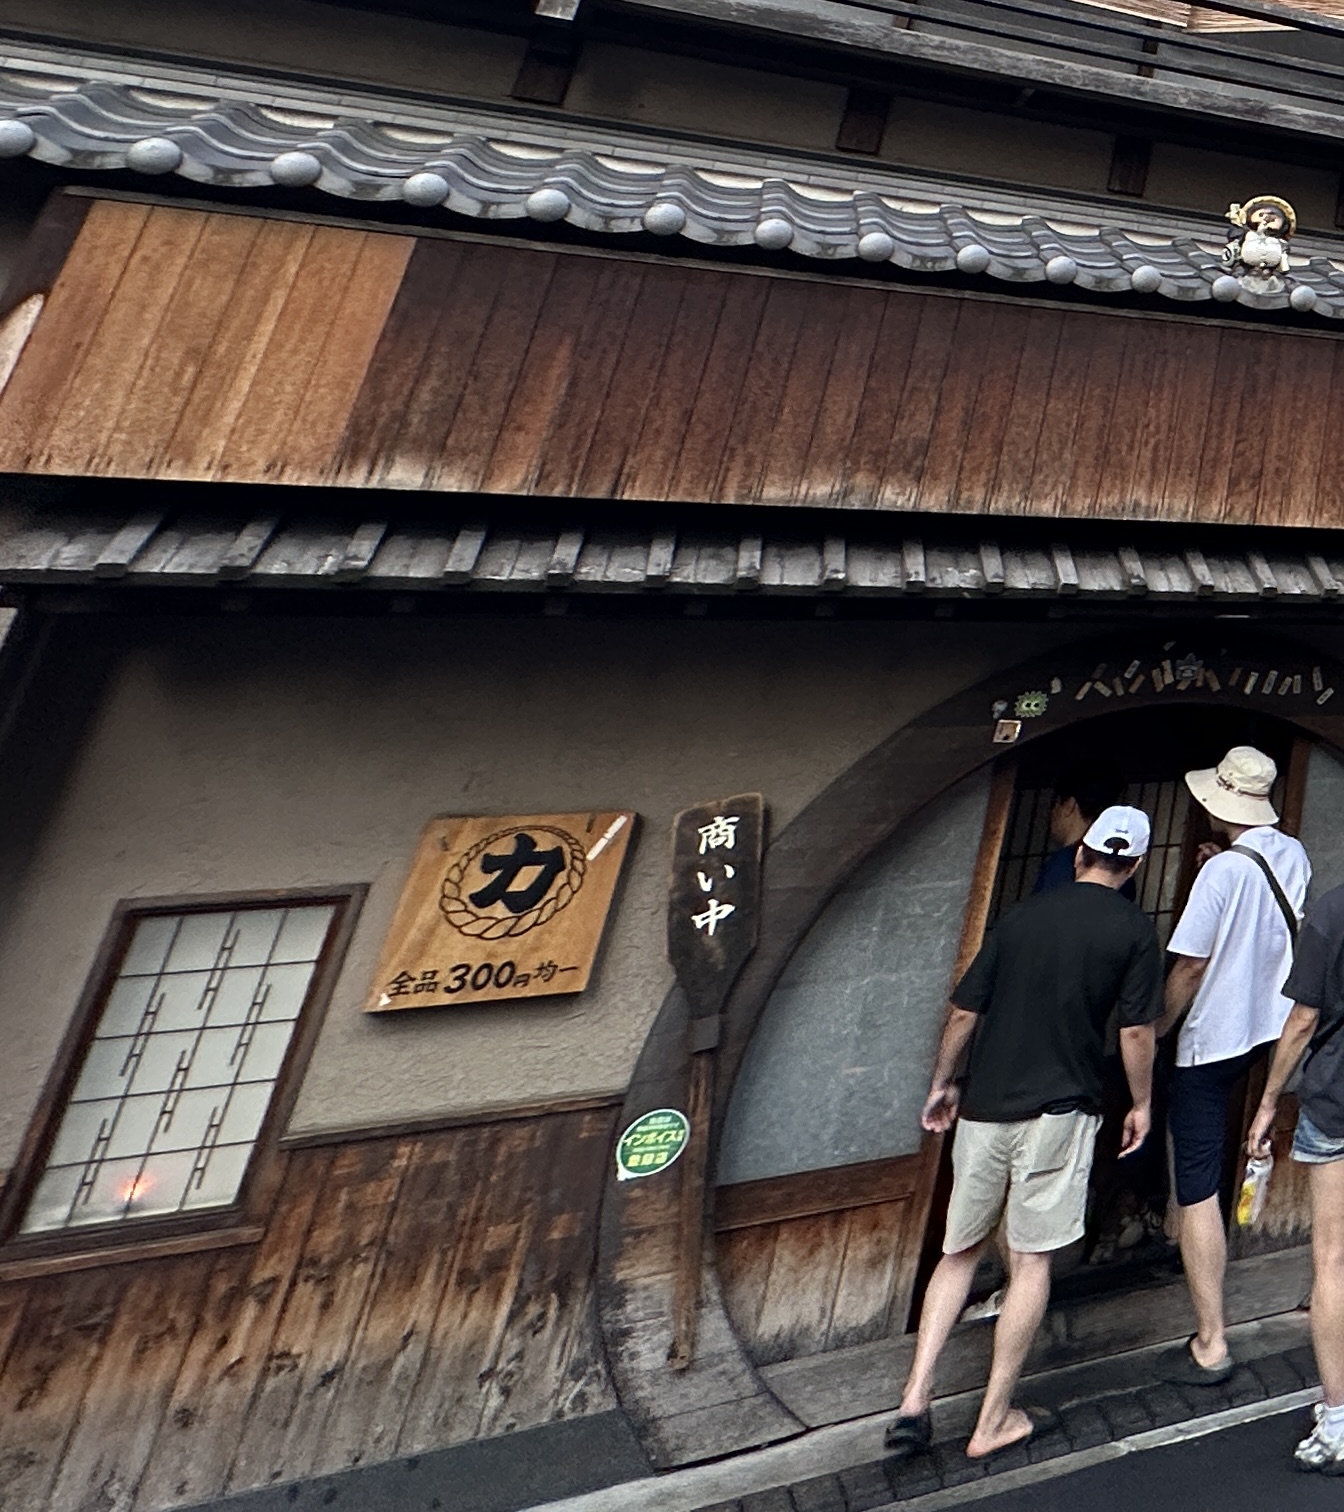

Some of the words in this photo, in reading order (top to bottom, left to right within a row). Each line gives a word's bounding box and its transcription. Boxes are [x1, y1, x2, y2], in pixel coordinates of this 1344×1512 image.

[469, 833, 566, 913] 力
[690, 816, 740, 937] 商い中
[387, 960, 580, 997] 全品300円均一
